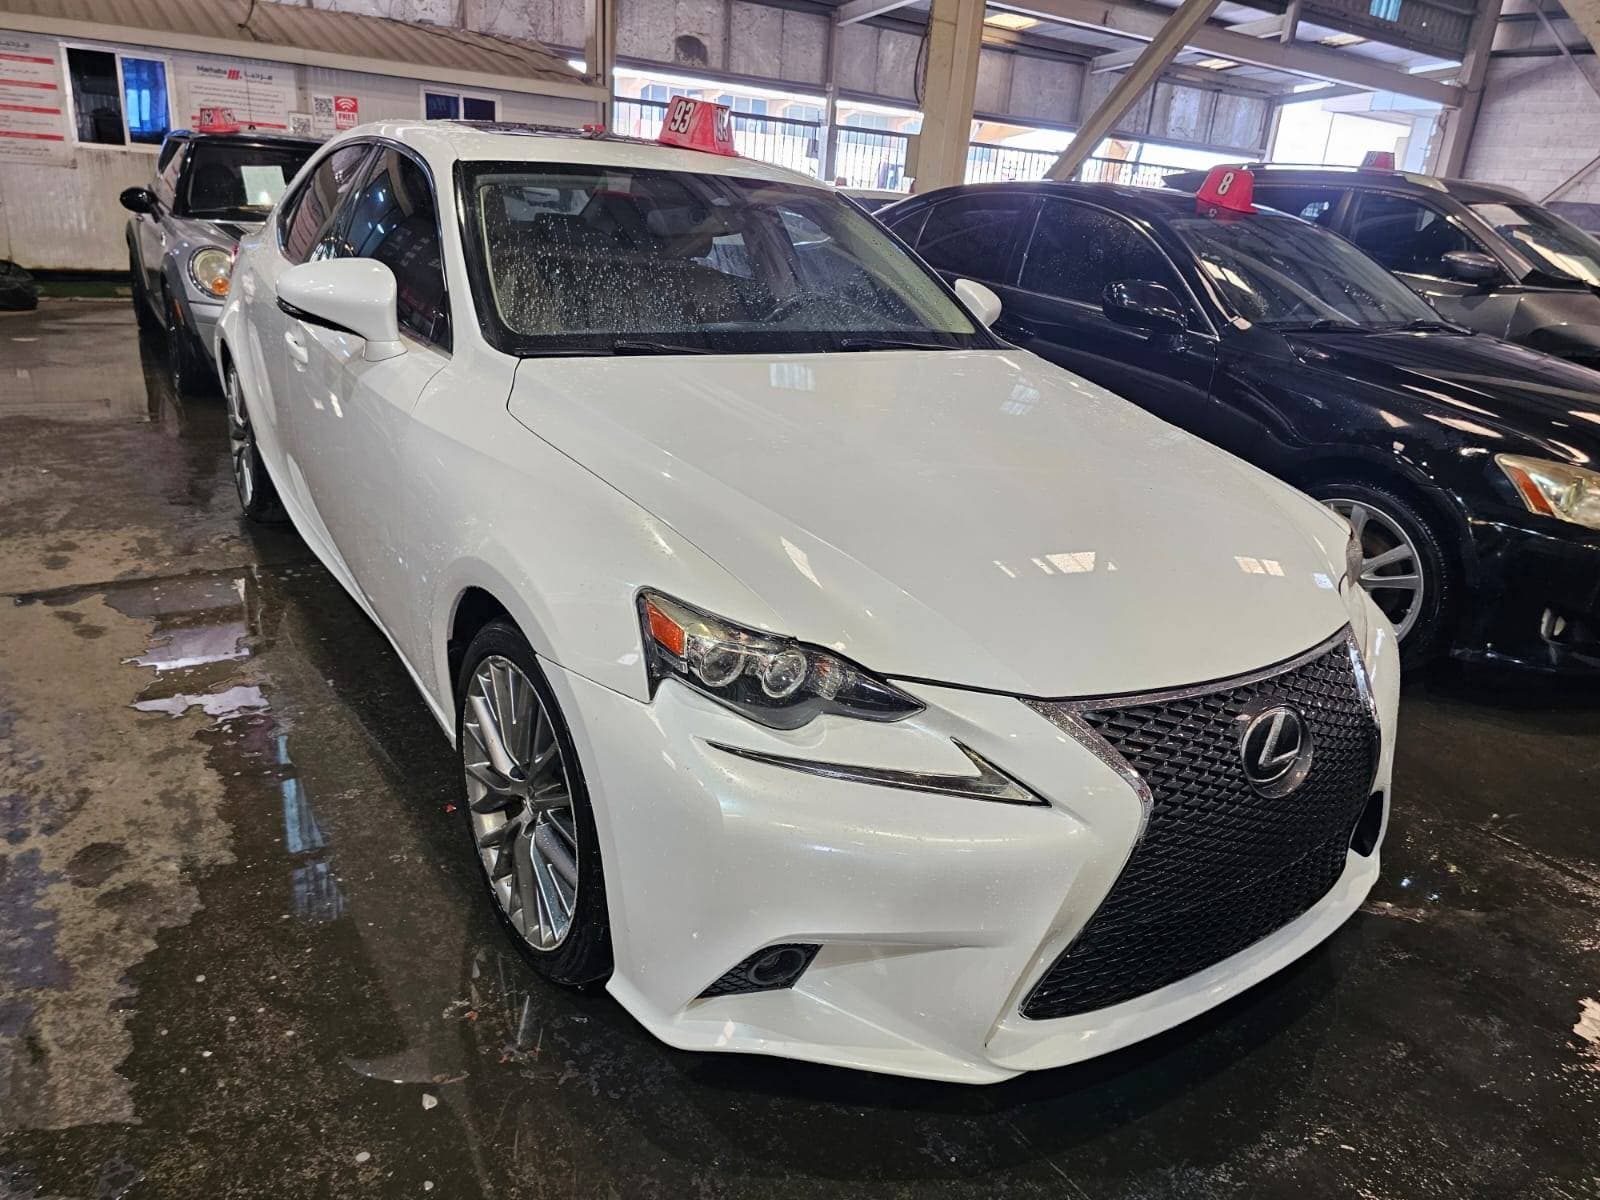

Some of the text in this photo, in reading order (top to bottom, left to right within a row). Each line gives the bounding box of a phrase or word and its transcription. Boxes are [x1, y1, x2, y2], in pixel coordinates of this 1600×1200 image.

[338, 112, 356, 121] FREE
[670, 101, 695, 134] 93
[1217, 171, 1234, 195] 8
